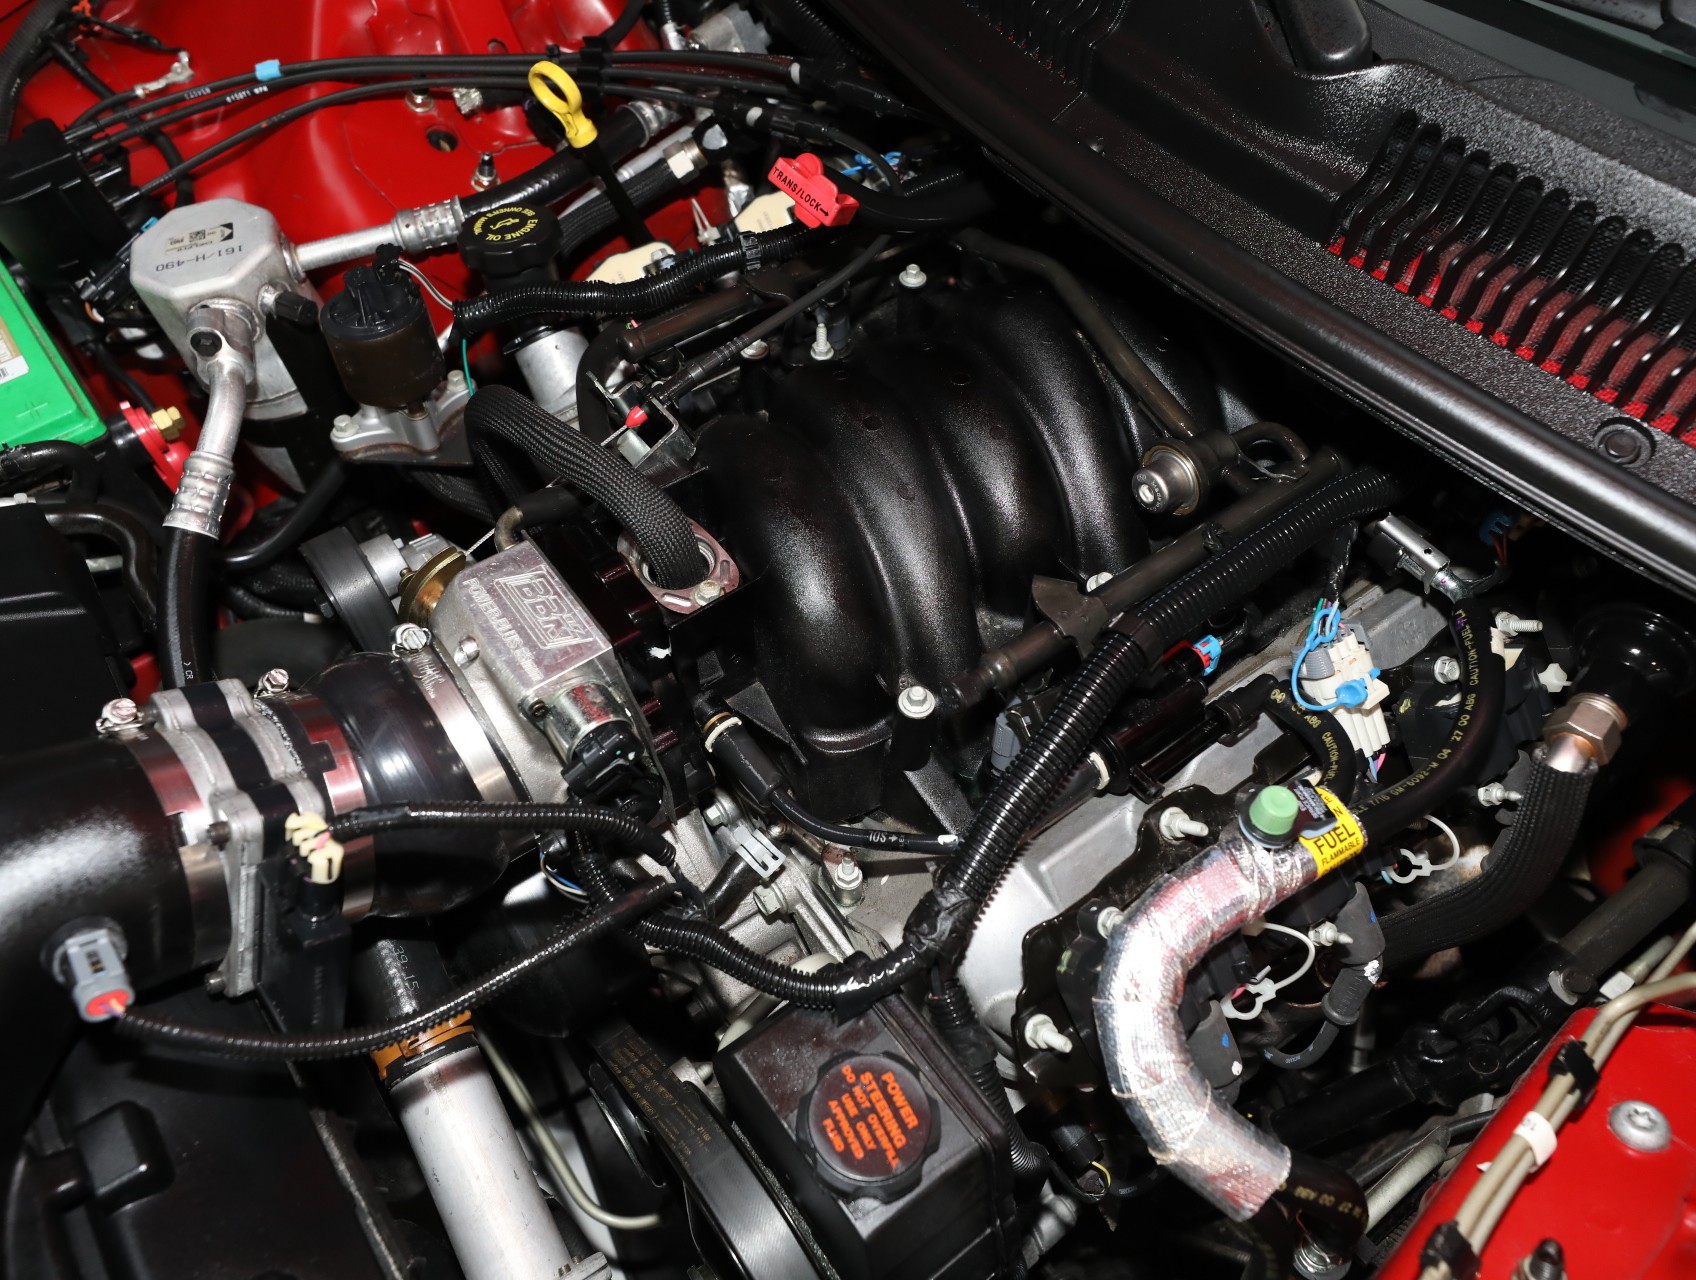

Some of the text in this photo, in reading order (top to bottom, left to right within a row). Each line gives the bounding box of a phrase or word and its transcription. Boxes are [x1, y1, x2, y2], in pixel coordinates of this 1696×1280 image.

[773, 166, 822, 211] TRANS/LOCK
[485, 219, 538, 241] ENGINE OIL
[156, 245, 242, 272] 161/H-490
[1464, 693, 1477, 711] ABG
[1450, 730, 1464, 742] 27
[1458, 714, 1471, 727] 00
[1313, 823, 1356, 855] FUEL
[841, 1064, 900, 1169] DO NOT OVERFILL
[860, 1071, 907, 1149] STEERING
[881, 1071, 919, 1130] POWER
[822, 1117, 845, 1153] FLUID
[828, 1099, 865, 1160] APPROVED
[841, 1092, 877, 1151] USE ONLY
